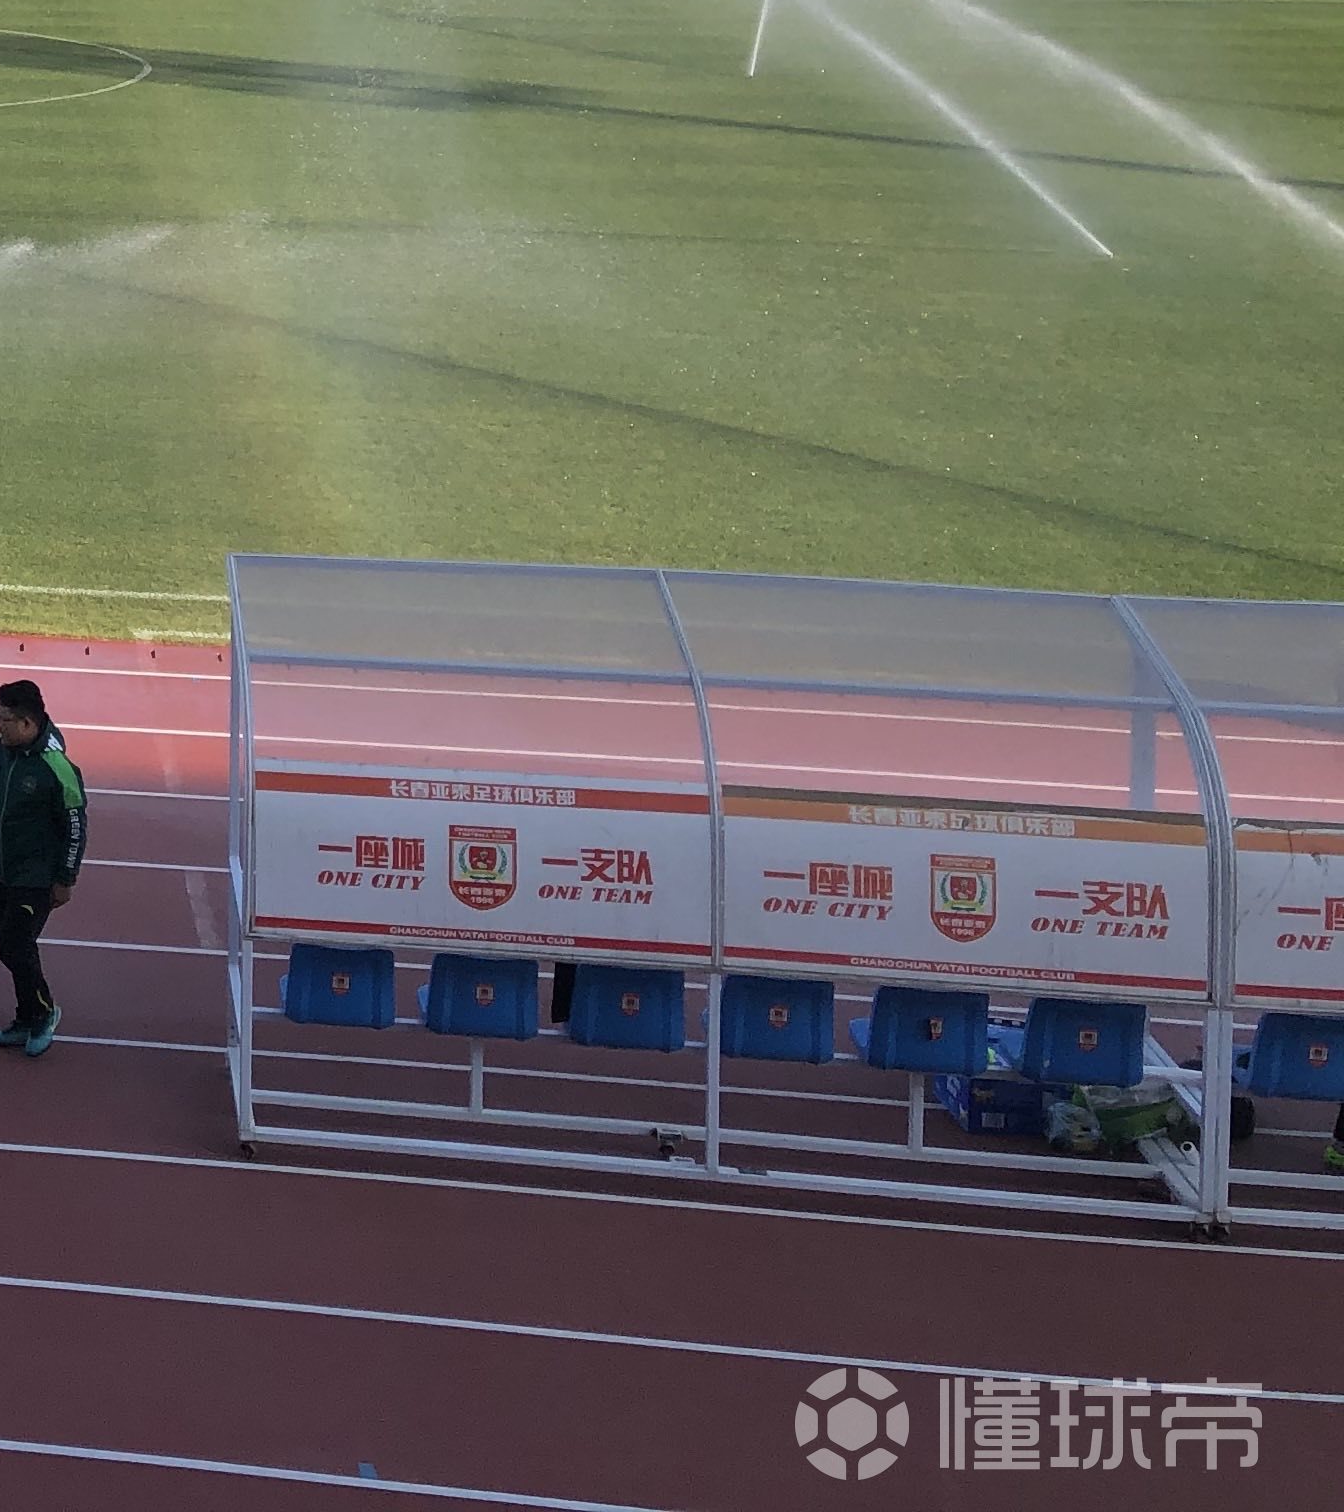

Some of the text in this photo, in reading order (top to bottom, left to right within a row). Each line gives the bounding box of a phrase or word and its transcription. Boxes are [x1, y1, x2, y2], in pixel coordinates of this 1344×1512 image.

[389, 778, 577, 807] 长春亚泰足球俱乐部
[848, 803, 1076, 837] 长春亚泰足球俱乐部
[317, 834, 426, 873] 一座城
[541, 848, 654, 887] 一支队
[316, 869, 427, 893] ONE CITY
[762, 862, 893, 902] 一座城
[537, 883, 654, 907] ONE TEAM
[1033, 879, 1172, 921] 一支队
[761, 896, 894, 922] ONE CITY
[389, 926, 576, 947] CHANGCHUN YATAI FOOTBALL CLUB
[1029, 915, 1170, 941] ONE TEAM
[1276, 933, 1335, 952] ONE
[850, 956, 1076, 982] CHANGCHUN YATAI FOOTBALL CLUB
